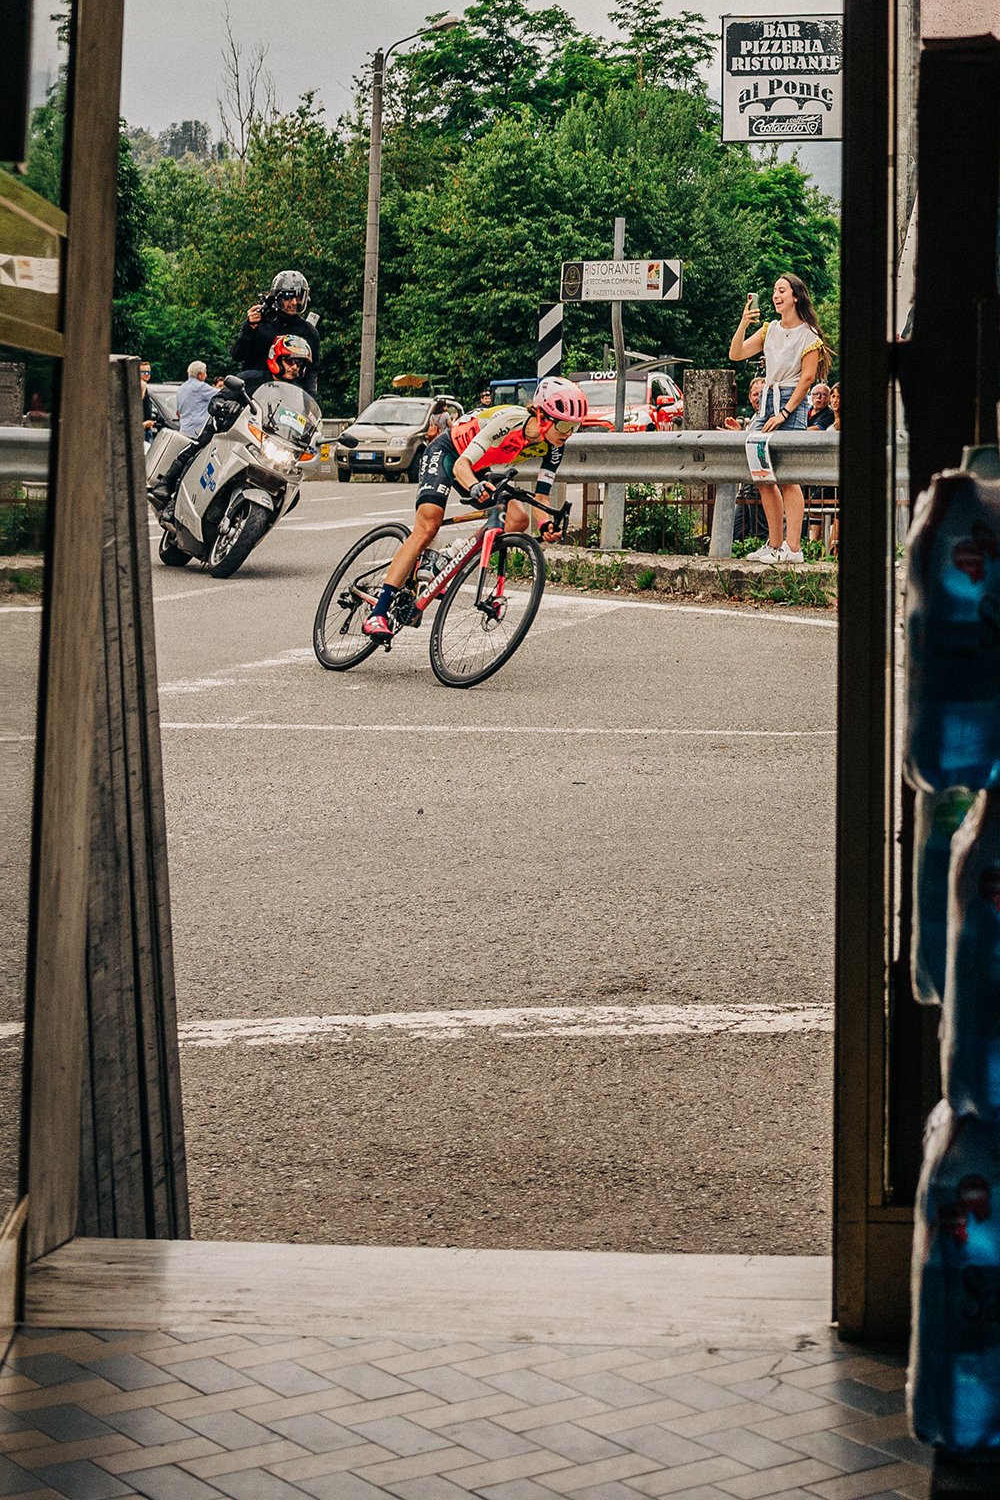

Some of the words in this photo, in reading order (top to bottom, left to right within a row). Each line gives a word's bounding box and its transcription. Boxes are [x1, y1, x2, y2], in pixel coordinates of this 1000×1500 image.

[763, 23, 801, 38] BAR
[740, 39, 824, 54] PIZZERIA
[731, 55, 840, 71] RISTORANTE
[739, 82, 759, 103] al
[768, 79, 834, 101] Ponte
[752, 118, 805, 134] Costadoro
[584, 262, 641, 276] RISTORANTE
[589, 371, 618, 380] TOYO
[422, 537, 477, 598] cannondale
